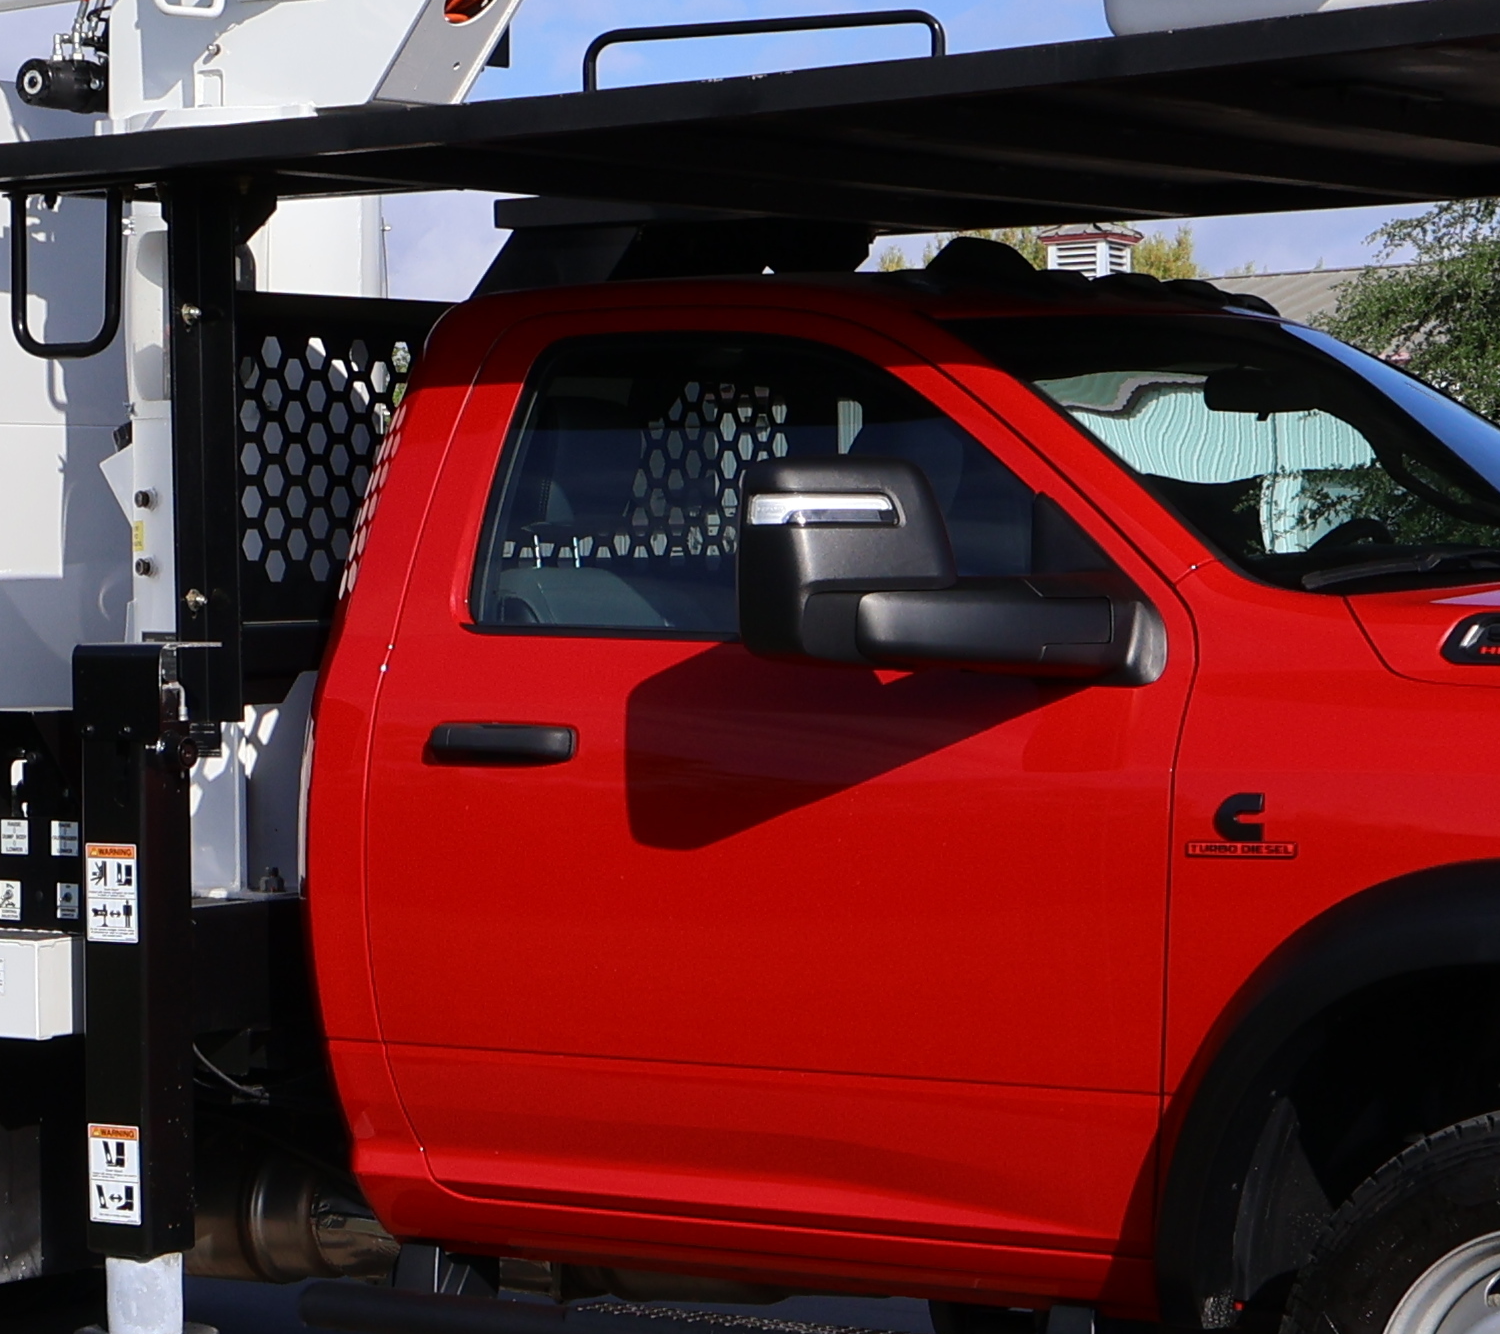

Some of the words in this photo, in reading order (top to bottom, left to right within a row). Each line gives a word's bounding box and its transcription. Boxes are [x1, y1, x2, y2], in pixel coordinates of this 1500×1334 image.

[98, 848, 132, 857] WARNING
[1190, 844, 1238, 854] TURBO
[1240, 844, 1292, 855] DIESEL
[100, 1128, 135, 1138] WARNING
